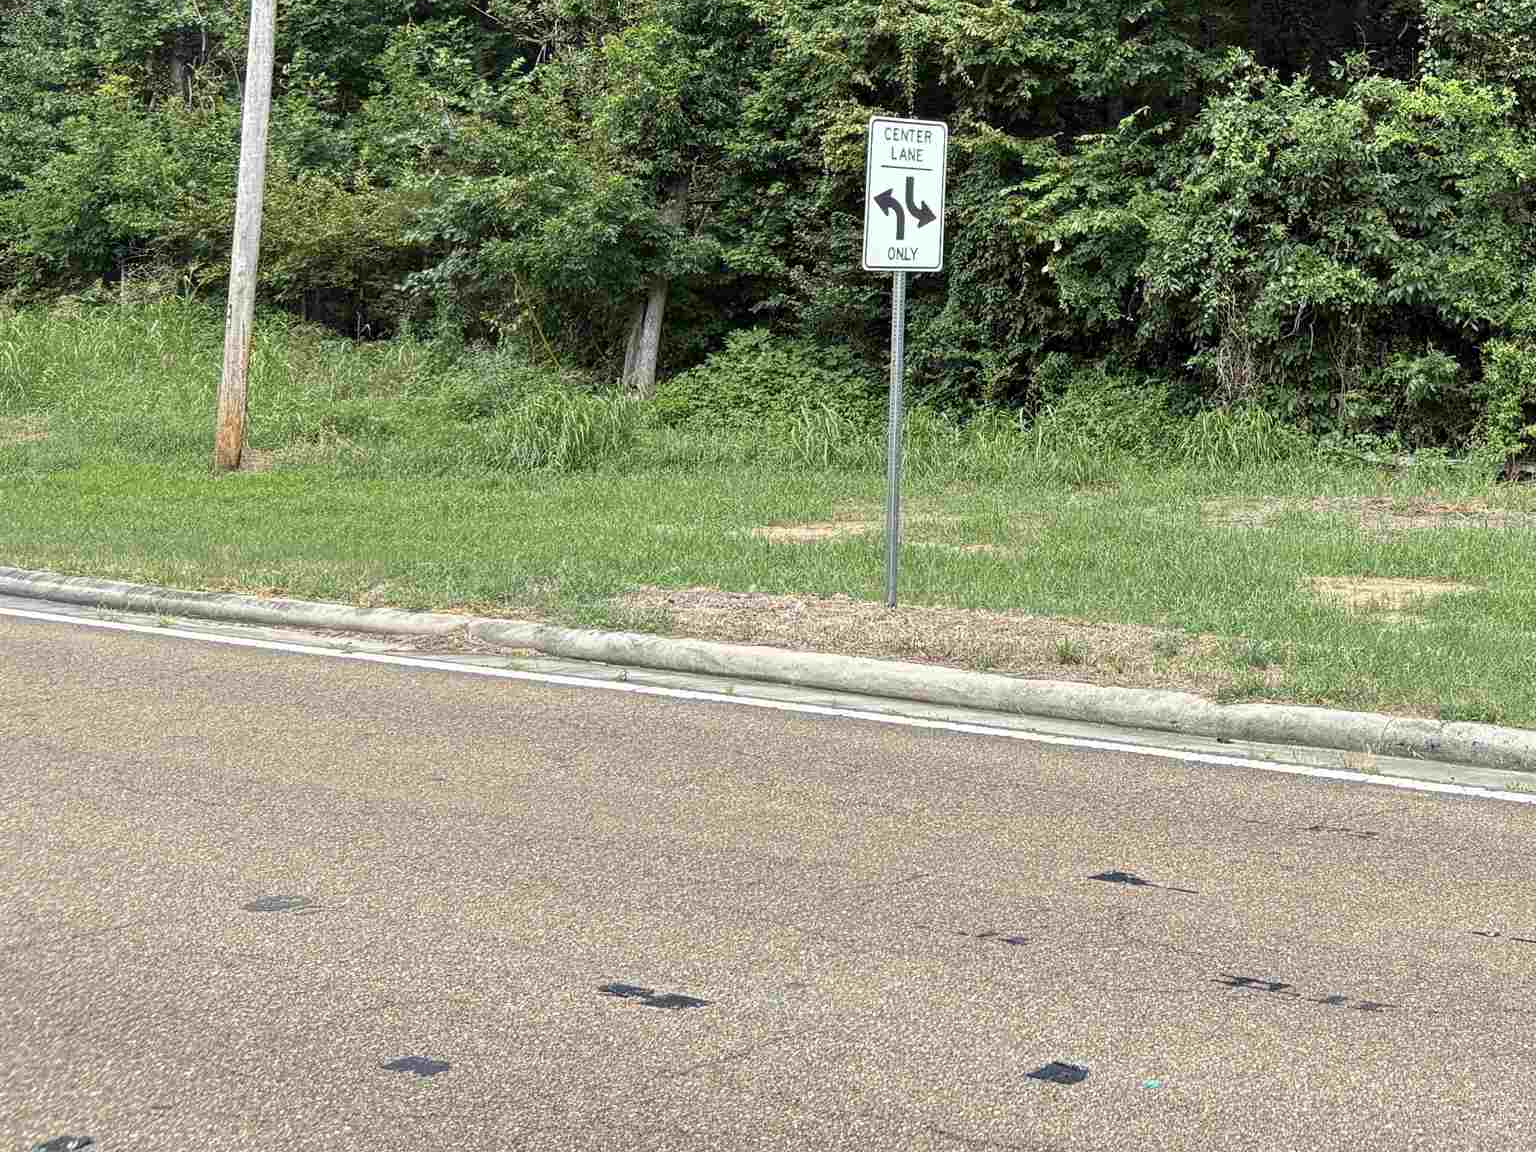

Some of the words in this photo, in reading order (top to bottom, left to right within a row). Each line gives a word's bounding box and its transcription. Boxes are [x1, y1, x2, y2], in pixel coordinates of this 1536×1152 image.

[884, 127, 932, 144] CENTER
[890, 146, 924, 162] LANE
[887, 247, 919, 262] ONLY
